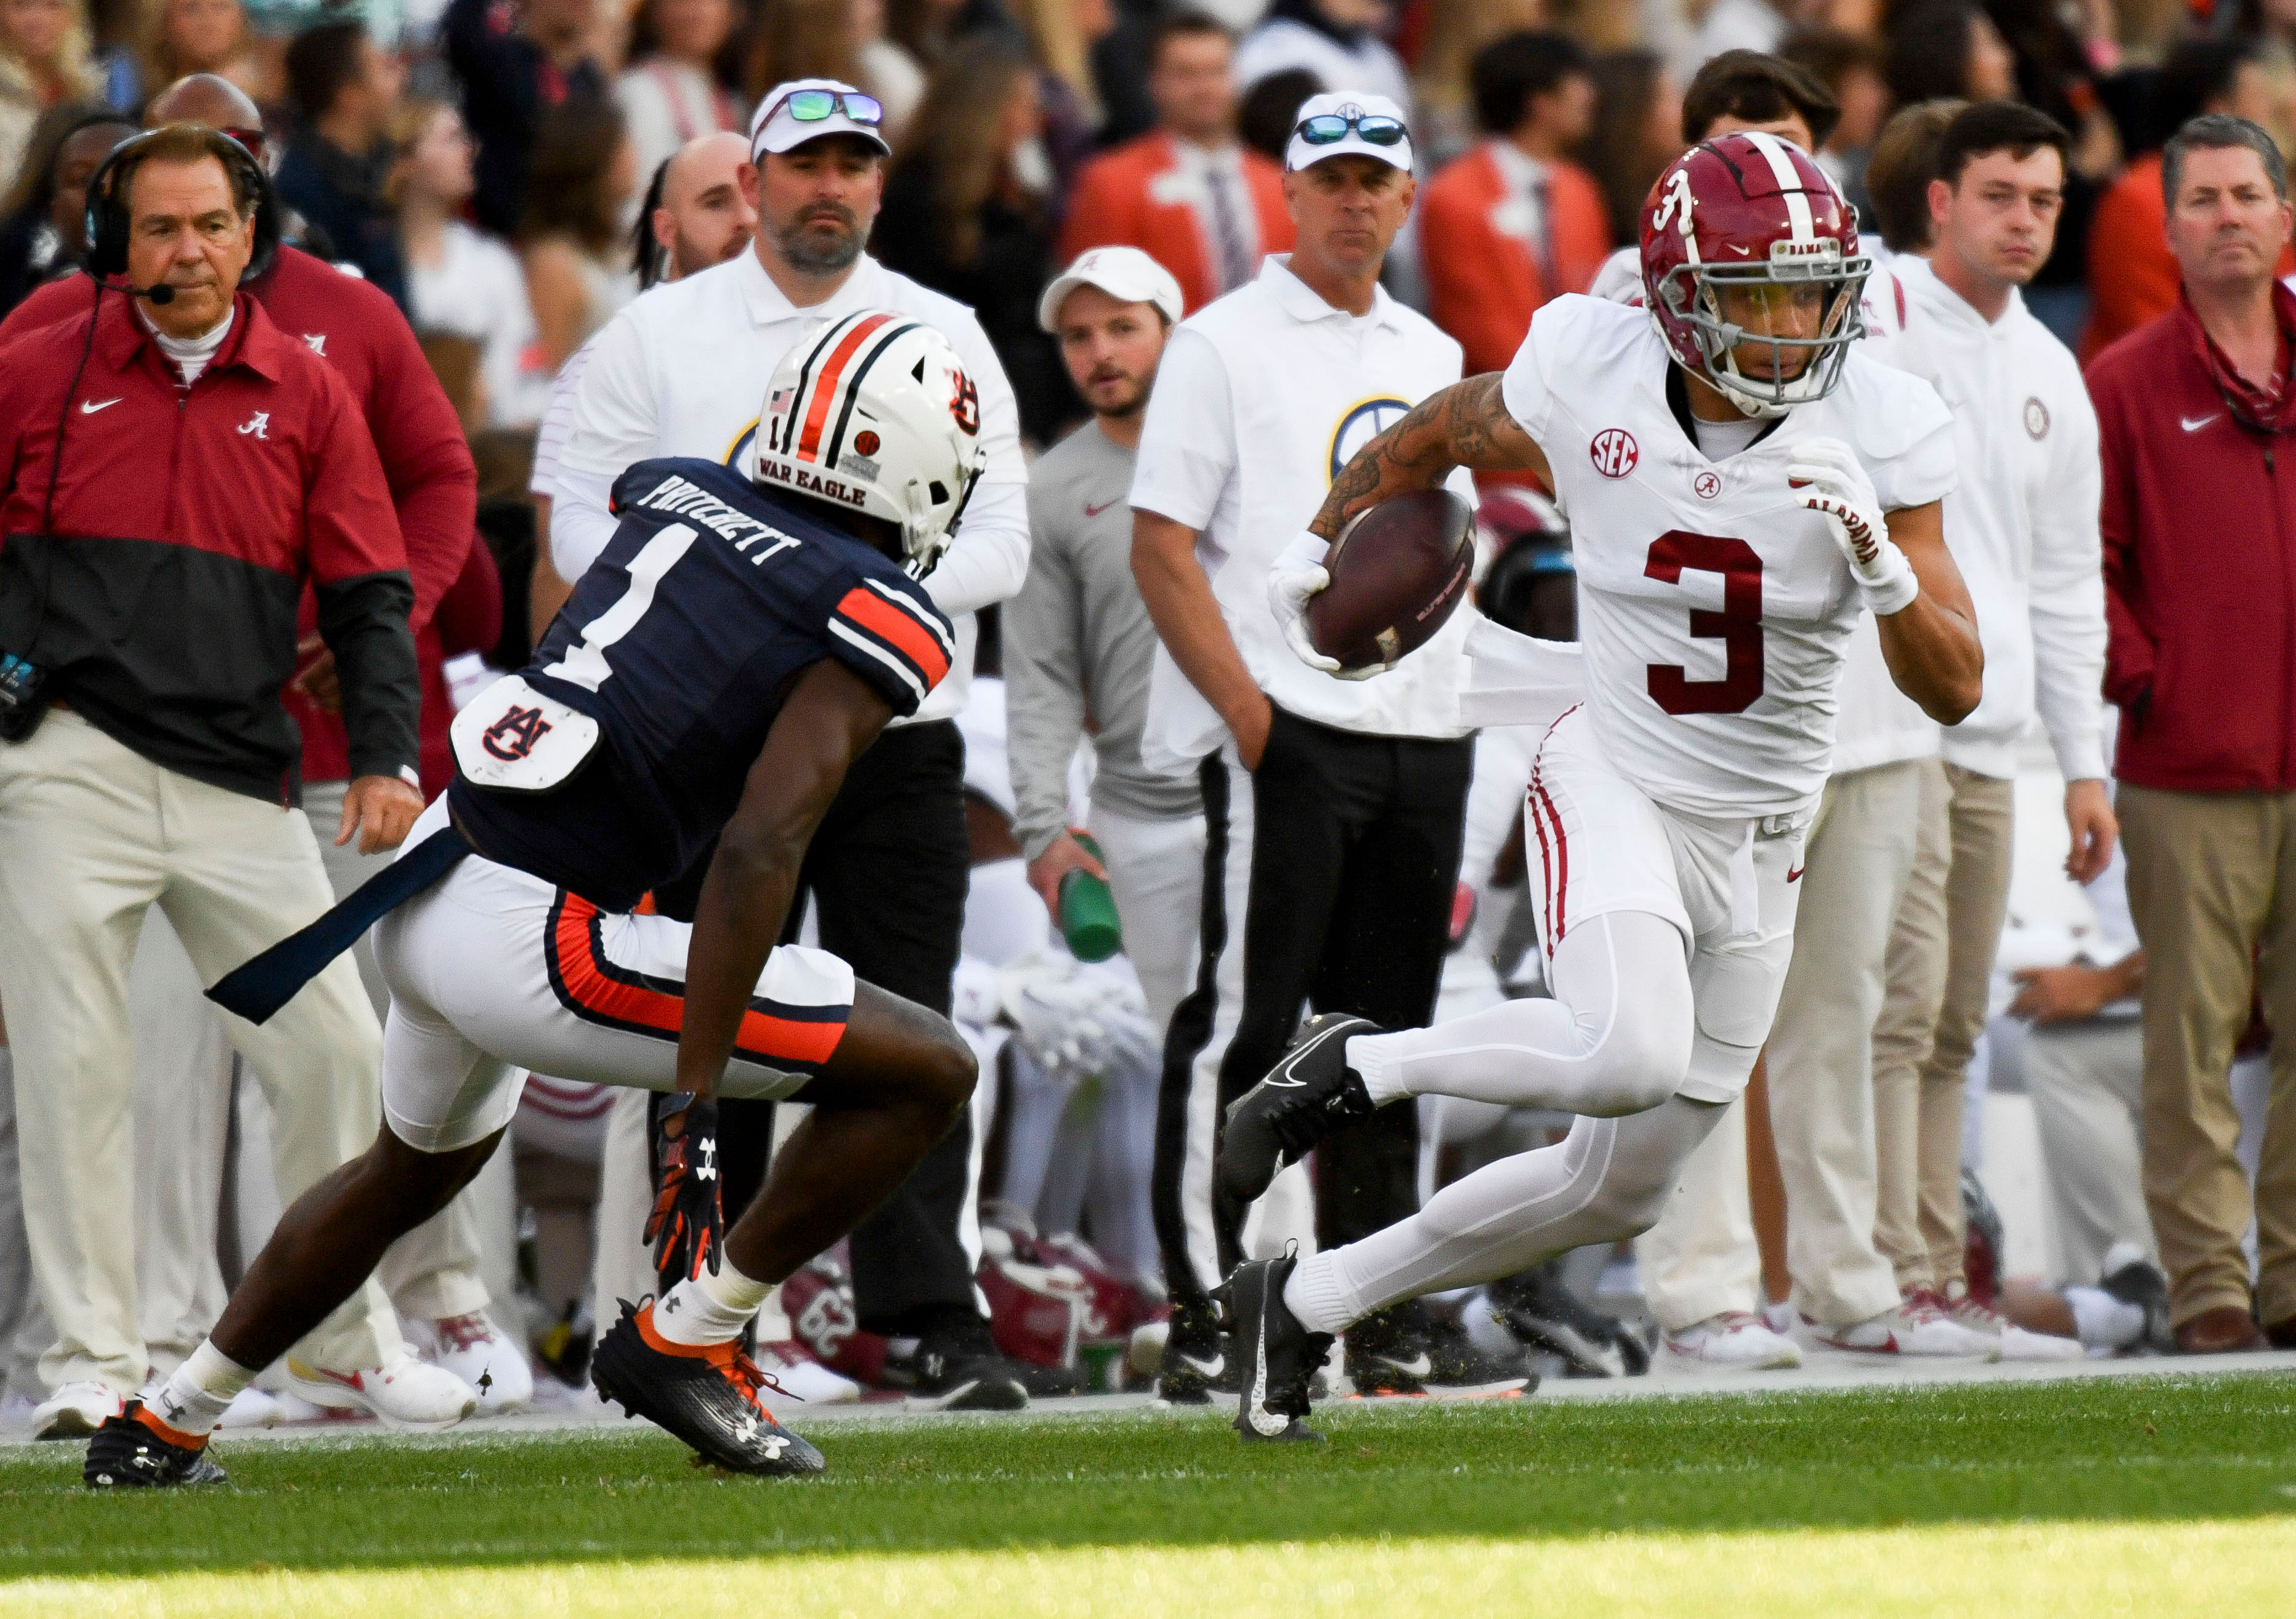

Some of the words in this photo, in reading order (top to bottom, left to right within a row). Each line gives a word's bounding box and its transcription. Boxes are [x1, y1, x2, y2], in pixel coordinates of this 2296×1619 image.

[1790, 244, 1822, 255] BAMA
[769, 416, 779, 450] 1
[1592, 430, 1637, 477] SEC
[760, 458, 792, 483] WAR
[795, 469, 867, 507] EAGLE
[636, 475, 801, 566] PRITCHETT
[542, 522, 699, 693] 1
[1644, 529, 1764, 715] 3
